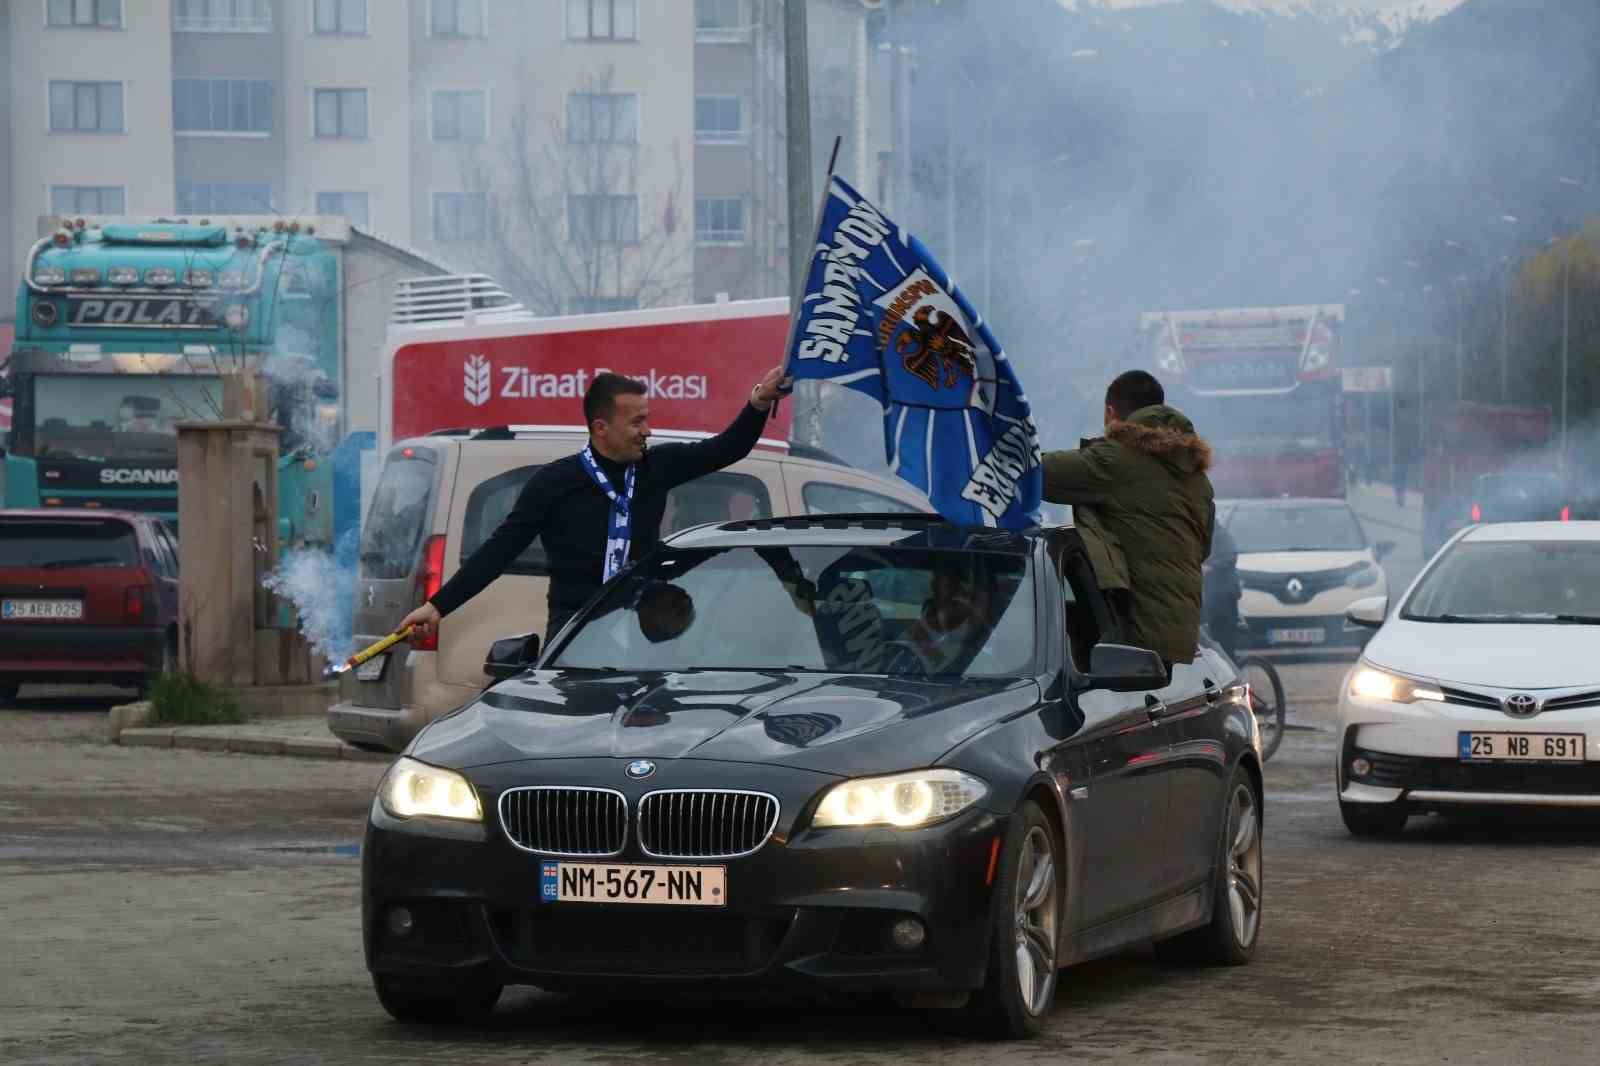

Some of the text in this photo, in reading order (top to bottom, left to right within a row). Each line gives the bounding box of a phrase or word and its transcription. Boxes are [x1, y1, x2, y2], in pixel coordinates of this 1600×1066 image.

[74, 300, 210, 324] POLAT
[501, 367, 707, 400] Ziraat nkası
[100, 468, 178, 484] SCANIA
[1472, 736, 1577, 757] 25 NB 691
[543, 867, 702, 900] GE NM-567-NN
